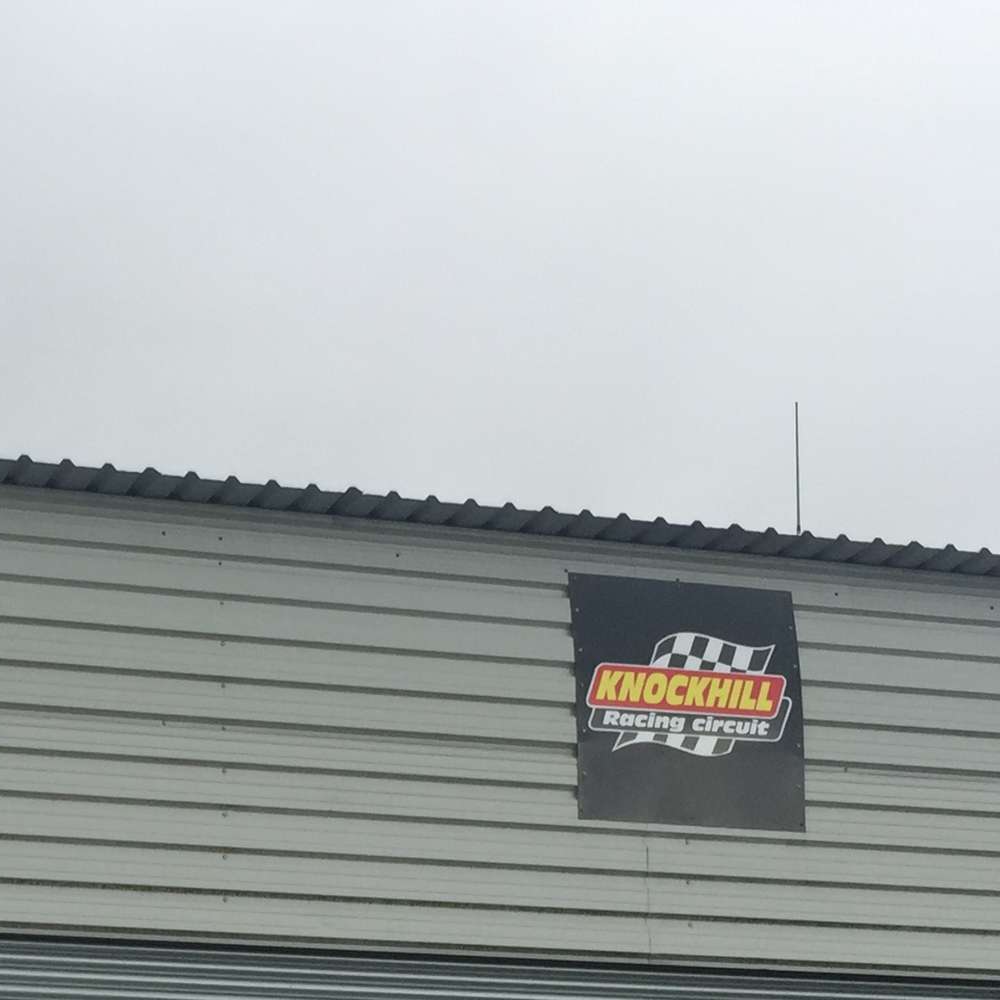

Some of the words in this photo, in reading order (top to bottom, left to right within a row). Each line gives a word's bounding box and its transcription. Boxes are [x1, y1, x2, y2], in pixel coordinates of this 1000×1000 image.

[596, 670, 773, 712] KNOCKHILL
[603, 710, 685, 732] Racing
[692, 716, 770, 736] circuit
